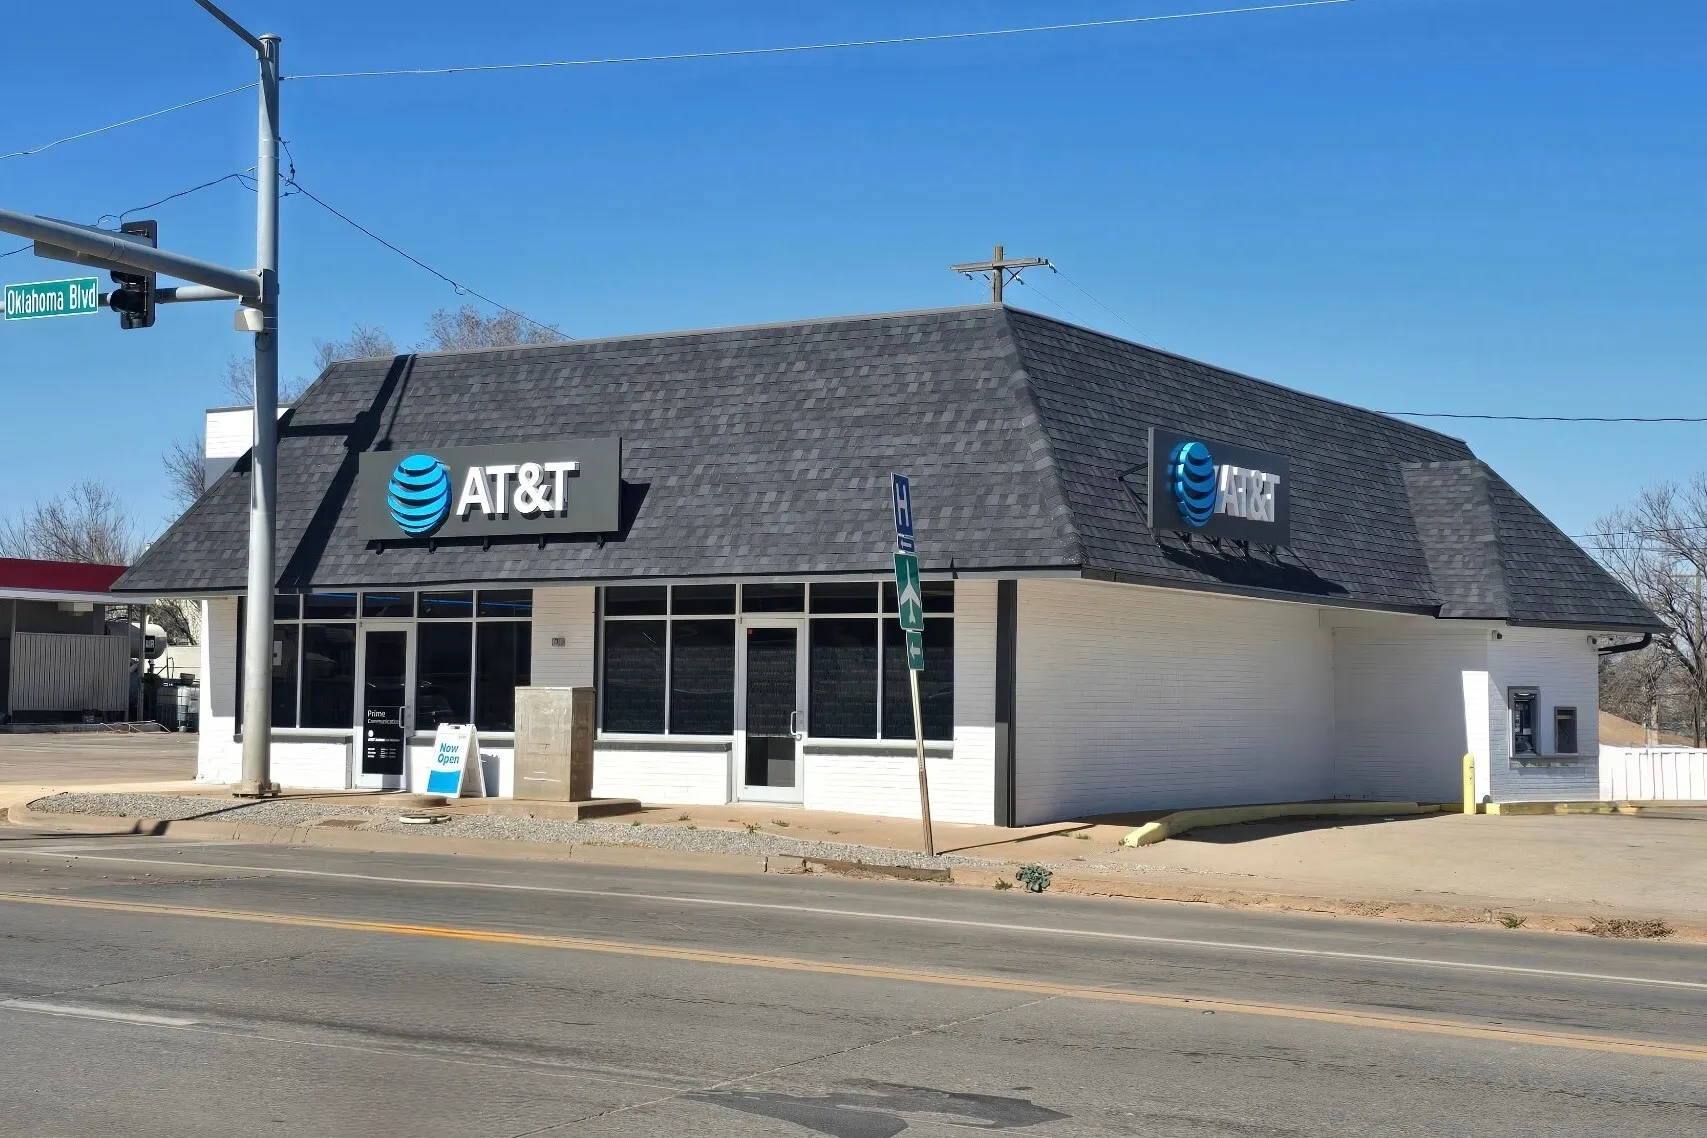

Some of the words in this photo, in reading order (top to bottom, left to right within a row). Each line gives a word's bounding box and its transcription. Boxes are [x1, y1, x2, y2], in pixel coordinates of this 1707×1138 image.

[7, 288, 64, 315] Oklahoma
[69, 283, 96, 309] Blvd
[456, 461, 580, 516] AT&T
[1214, 464, 1281, 523] AT&T
[895, 482, 910, 528] H
[367, 710, 386, 718] Prime
[437, 753, 460, 766] Open
[439, 742, 459, 753] Now
